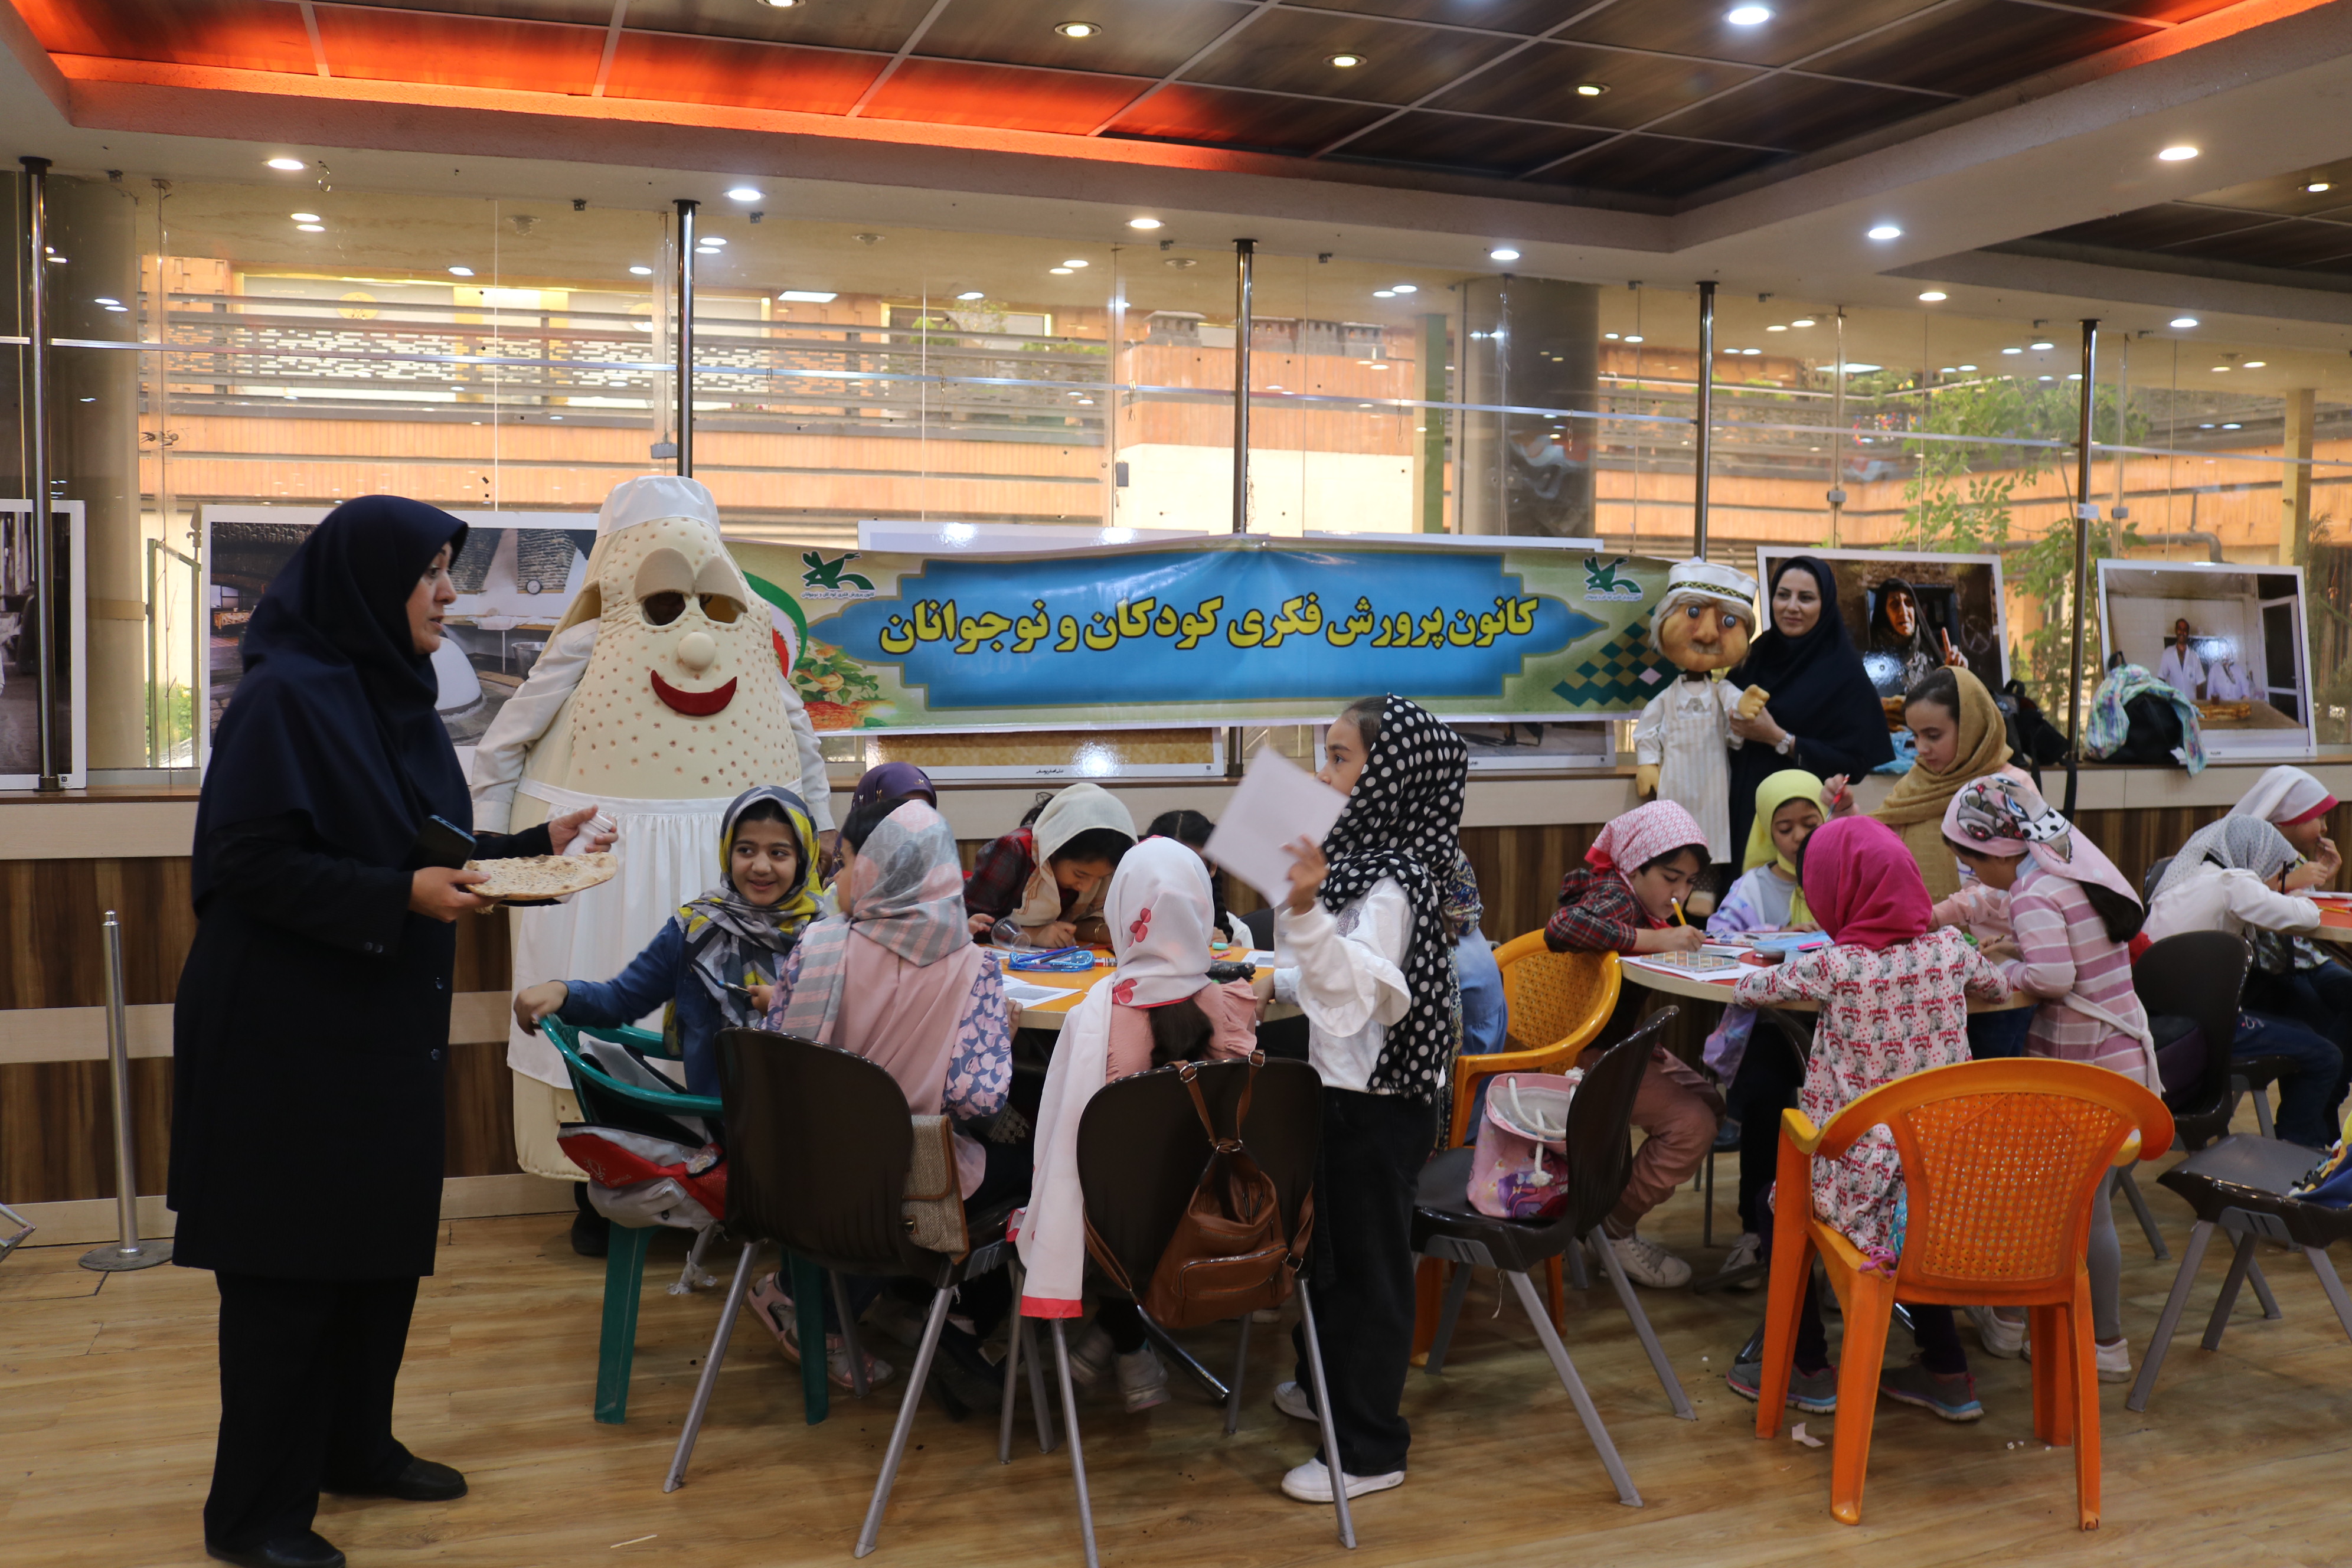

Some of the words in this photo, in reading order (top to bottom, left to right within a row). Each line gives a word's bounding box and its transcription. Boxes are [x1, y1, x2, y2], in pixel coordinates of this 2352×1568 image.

[1054, 615, 1080, 652] و
[1083, 596, 1224, 650] کودکان
[1226, 592, 1323, 648] فکری
[1325, 596, 1446, 649] پرورش
[1447, 596, 1538, 647] کانون
